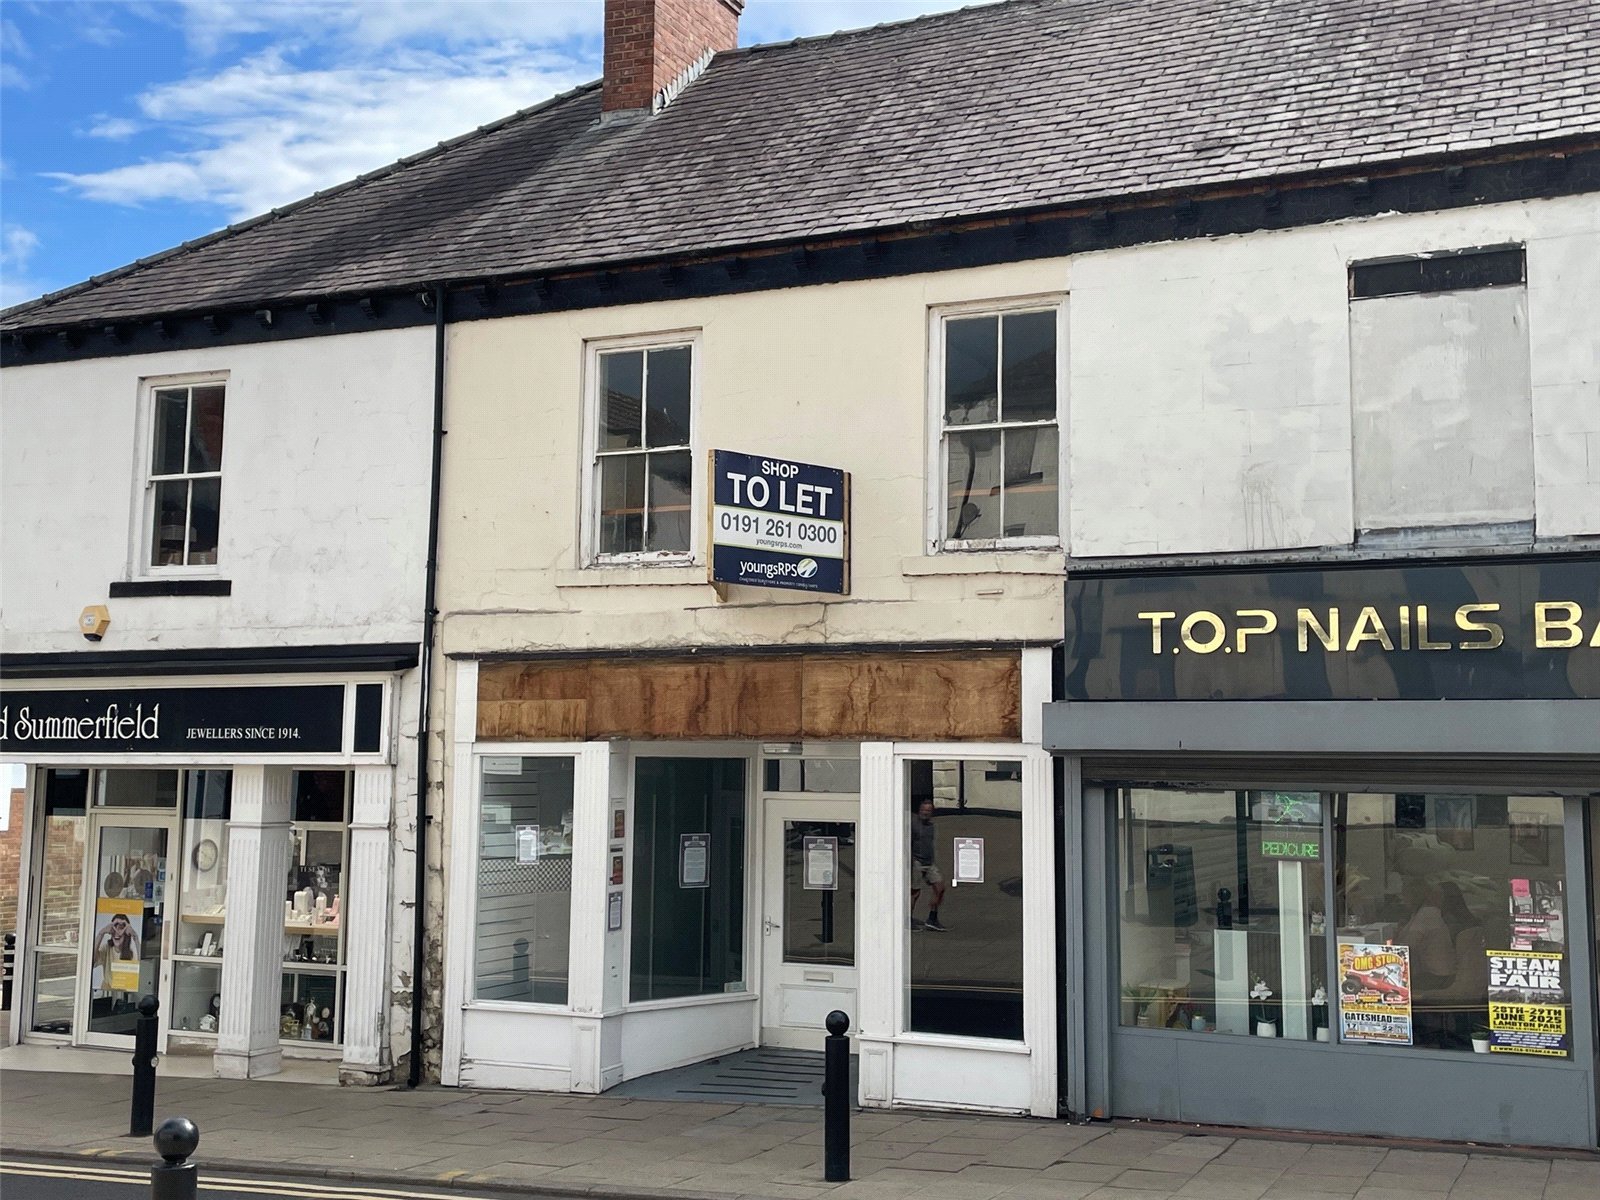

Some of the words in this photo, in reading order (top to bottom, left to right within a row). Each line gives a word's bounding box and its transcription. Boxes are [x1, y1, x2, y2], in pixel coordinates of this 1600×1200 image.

[761, 460, 799, 478] SHOP
[727, 472, 770, 508] TO
[779, 480, 833, 516] LET
[721, 512, 759, 534] 0191
[766, 518, 792, 539] 261
[798, 523, 837, 543] 0300
[755, 539, 803, 549] youngsrps.com
[739, 560, 798, 579] youngsRPS
[1138, 609, 1278, 654] T.O.P
[1297, 603, 1504, 652] NAILS
[1535, 601, 1600, 648] B
[14, 703, 159, 740] Summerfield
[186, 728, 242, 740] JEWELLERS
[245, 727, 275, 739] SINCE
[278, 727, 301, 739] 1914.
[1262, 841, 1319, 858] PEDICURE
[1354, 956, 1374, 970] OMG
[1490, 956, 1560, 972] STEAM
[1504, 968, 1560, 977] VINTAGE
[1490, 973, 1560, 988] FAIR
[1345, 1012, 1392, 1023] GATESHEAD
[1492, 1005, 1562, 1016] 28TH-29TH
[1493, 1013, 1525, 1021] JUNE
[1529, 1014, 1562, 1024] 2025
[1494, 1020, 1536, 1028] LAMBTON
